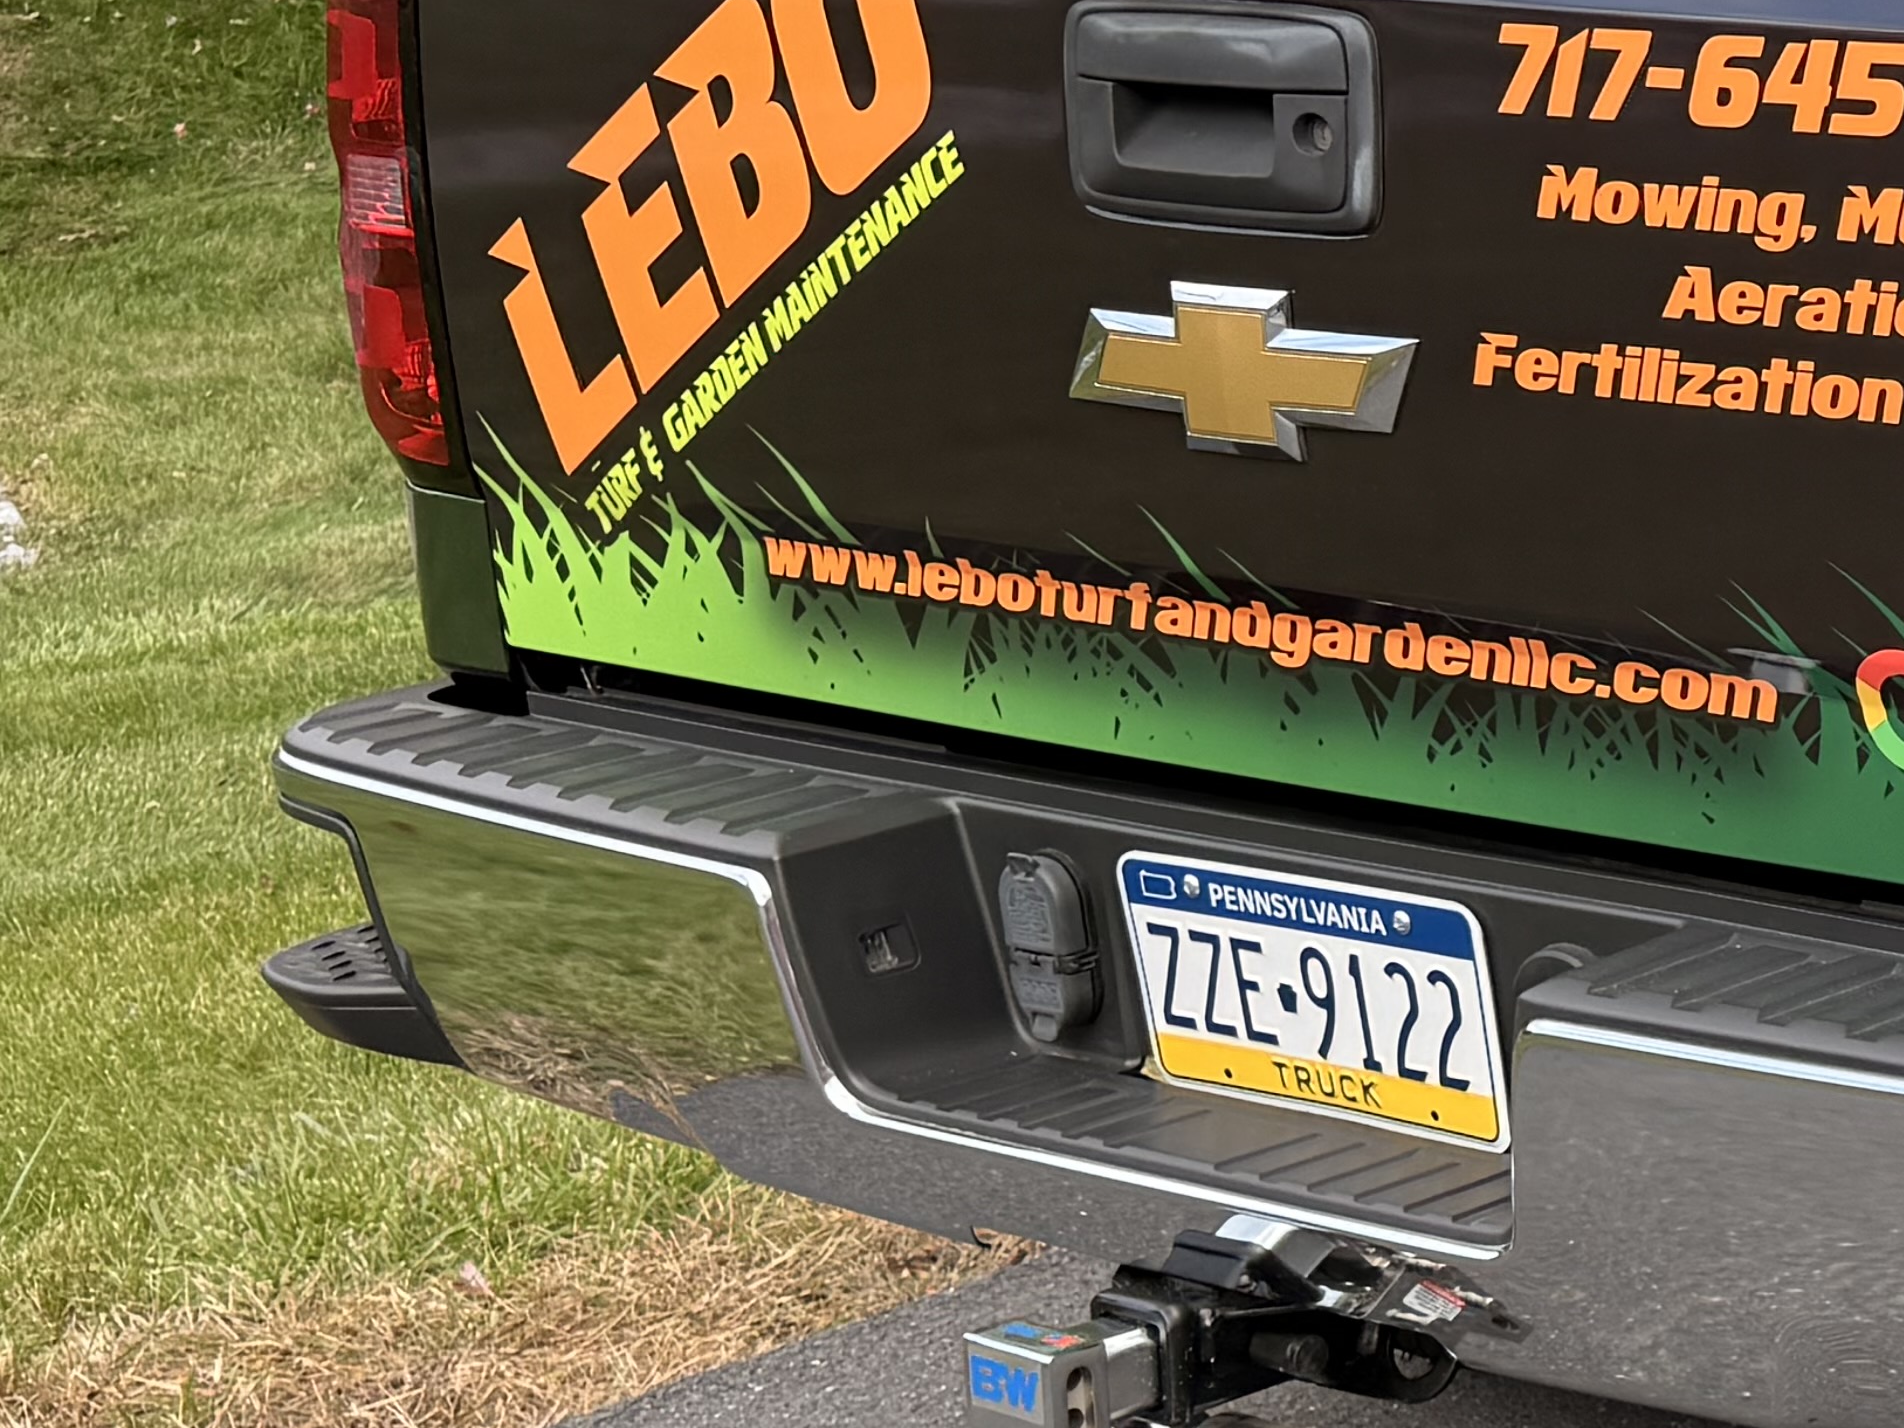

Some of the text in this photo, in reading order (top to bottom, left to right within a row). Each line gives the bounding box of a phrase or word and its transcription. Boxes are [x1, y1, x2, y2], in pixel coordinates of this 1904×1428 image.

[1537, 164, 1817, 253] Mowing,
[585, 447, 644, 534] TURF
[662, 322, 769, 453] GARDEN
[763, 130, 965, 353] MAINTENANCE
[1472, 332, 1904, 426] Fertilization
[762, 535, 1779, 724] www.leboturfandgardenllc.com
[1208, 882, 1388, 936] PENNSYLVANIA
[1273, 1062, 1383, 1110] TRUCK
